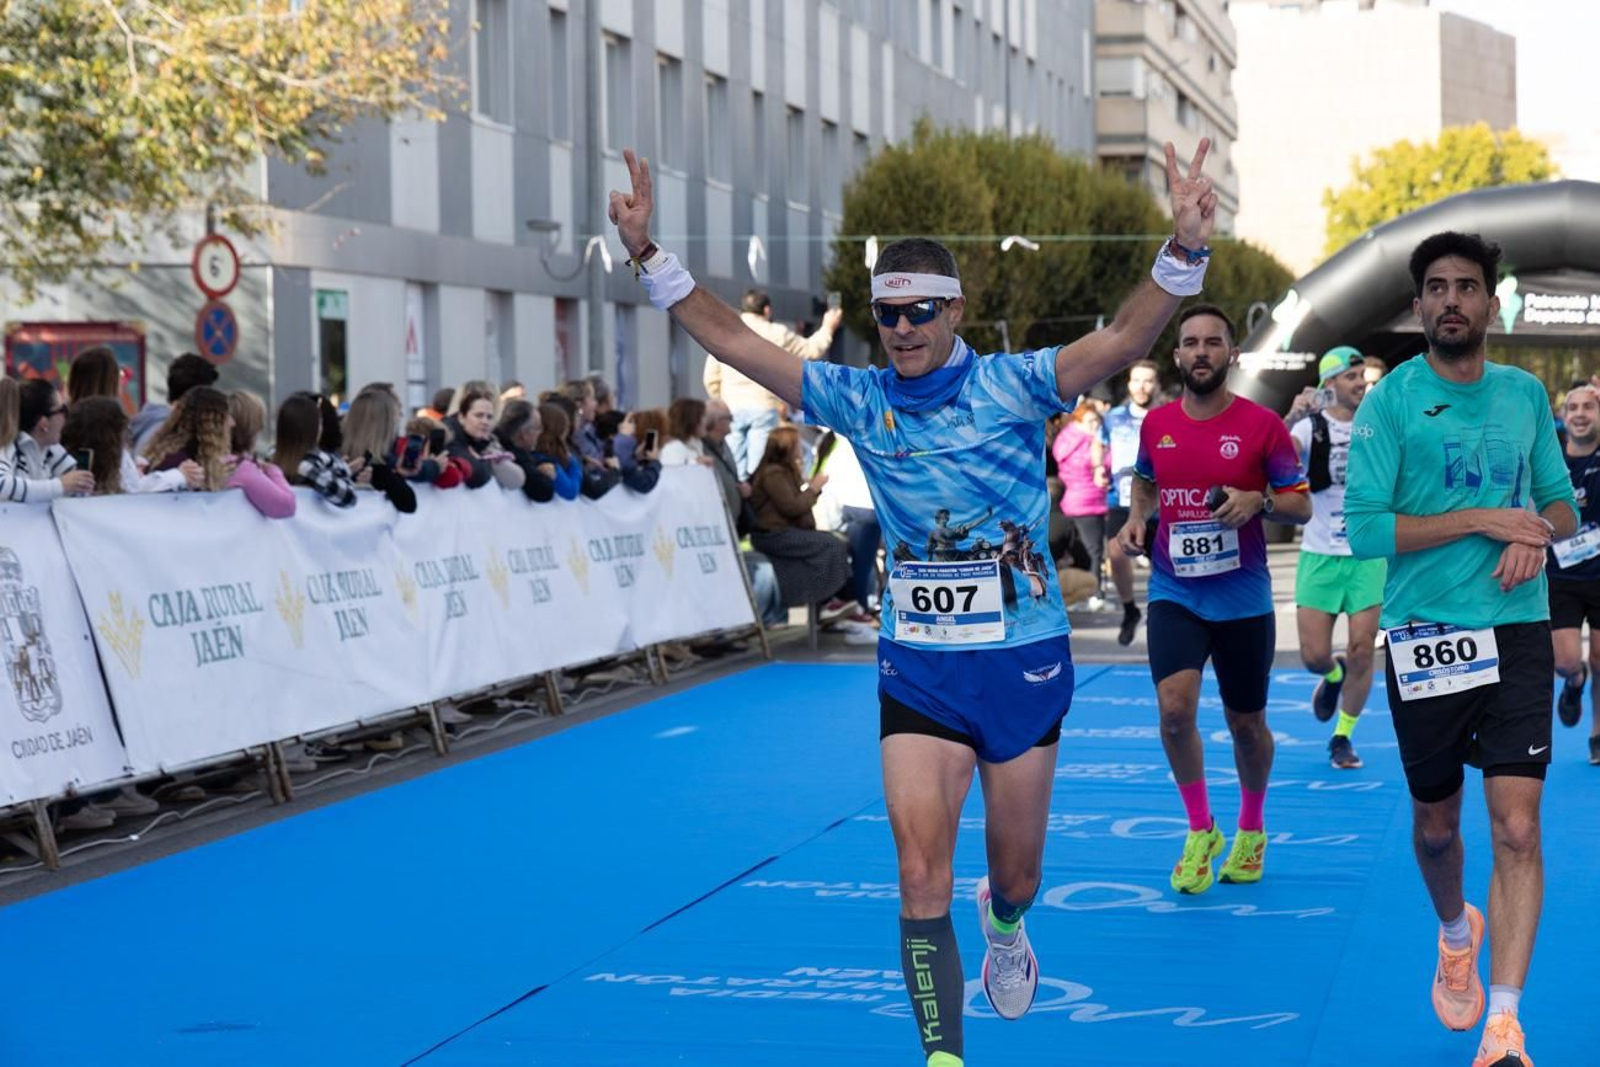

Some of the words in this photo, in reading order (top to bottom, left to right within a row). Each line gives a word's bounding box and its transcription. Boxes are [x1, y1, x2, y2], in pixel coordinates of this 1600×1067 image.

[1182, 533, 1224, 556] 881
[148, 589, 202, 628] CAJA
[201, 581, 264, 621] RURAL
[911, 585, 978, 613] 607
[190, 621, 245, 668] JAÉN
[1413, 636, 1477, 669] 860
[47, 731, 65, 752] DE
[783, 966, 905, 979] AÉN
[669, 987, 887, 1001] MEDIA
[906, 938, 943, 1043] kalenji
